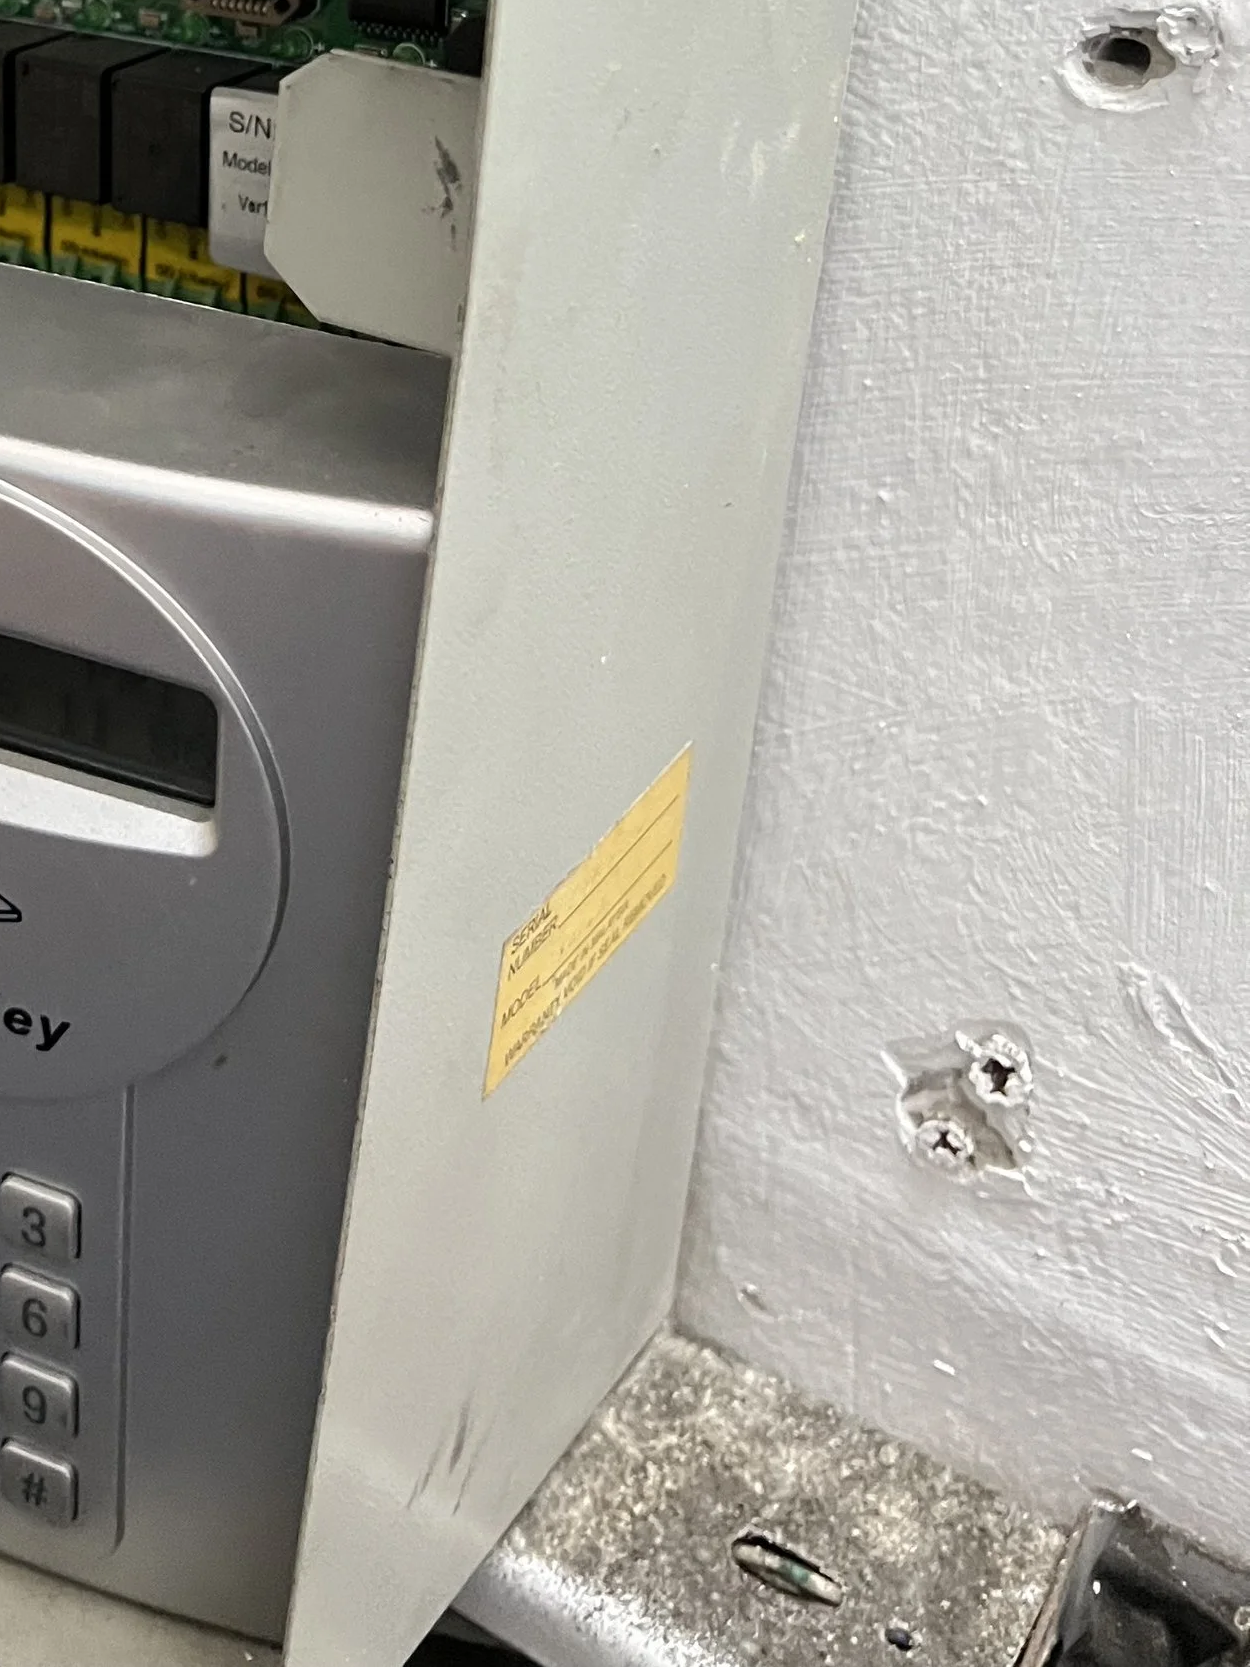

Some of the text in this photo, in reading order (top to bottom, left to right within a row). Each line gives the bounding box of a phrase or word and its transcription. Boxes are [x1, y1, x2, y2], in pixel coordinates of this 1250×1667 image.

[507, 914, 559, 982] NUMBER
[510, 901, 552, 955] SERIAL
[500, 973, 542, 1030] MODEL
[21, 1205, 47, 1247] 3
[21, 1298, 48, 1337] 6
[22, 1385, 47, 1424] 9
